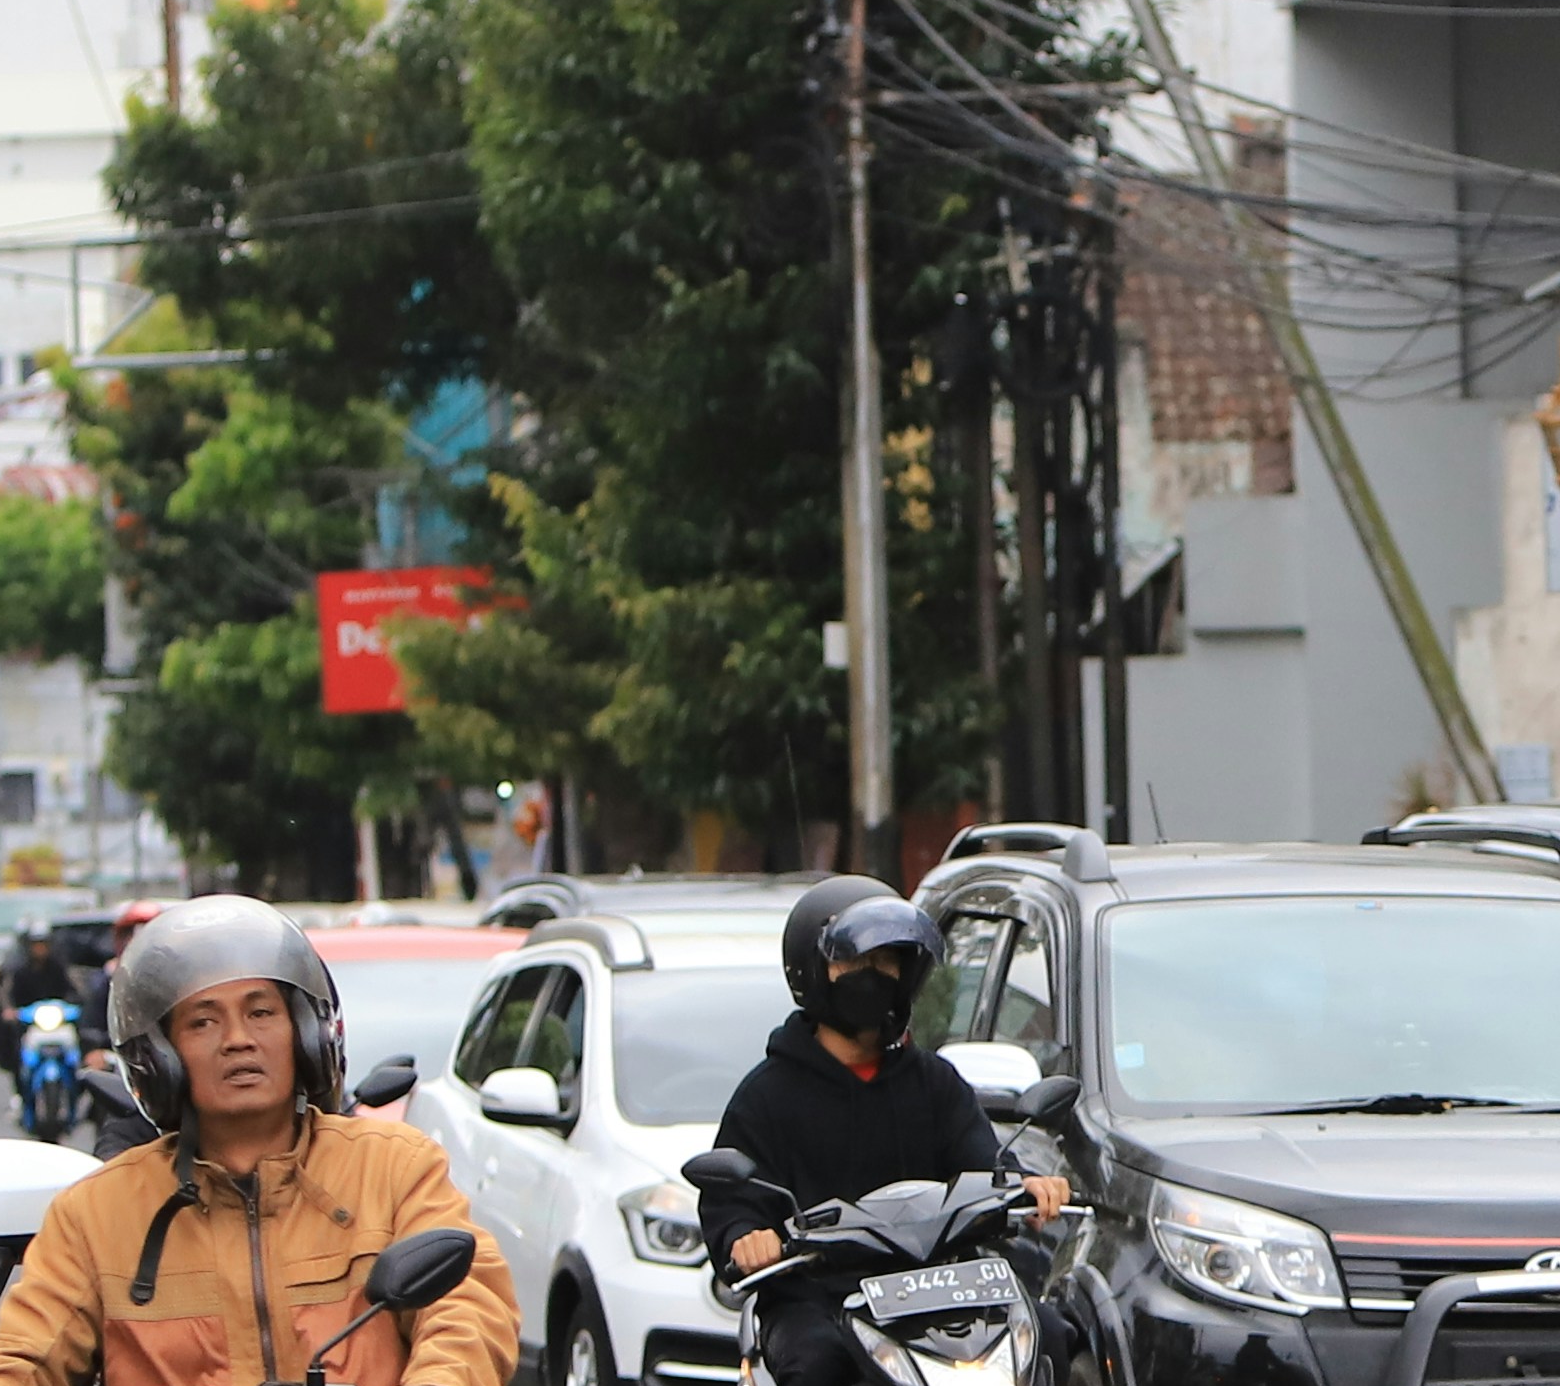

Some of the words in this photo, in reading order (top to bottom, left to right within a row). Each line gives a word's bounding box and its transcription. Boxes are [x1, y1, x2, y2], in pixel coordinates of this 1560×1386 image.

[867, 1282, 884, 1299] N
[902, 1269, 960, 1292] 3442
[980, 1263, 1008, 1281] CU
